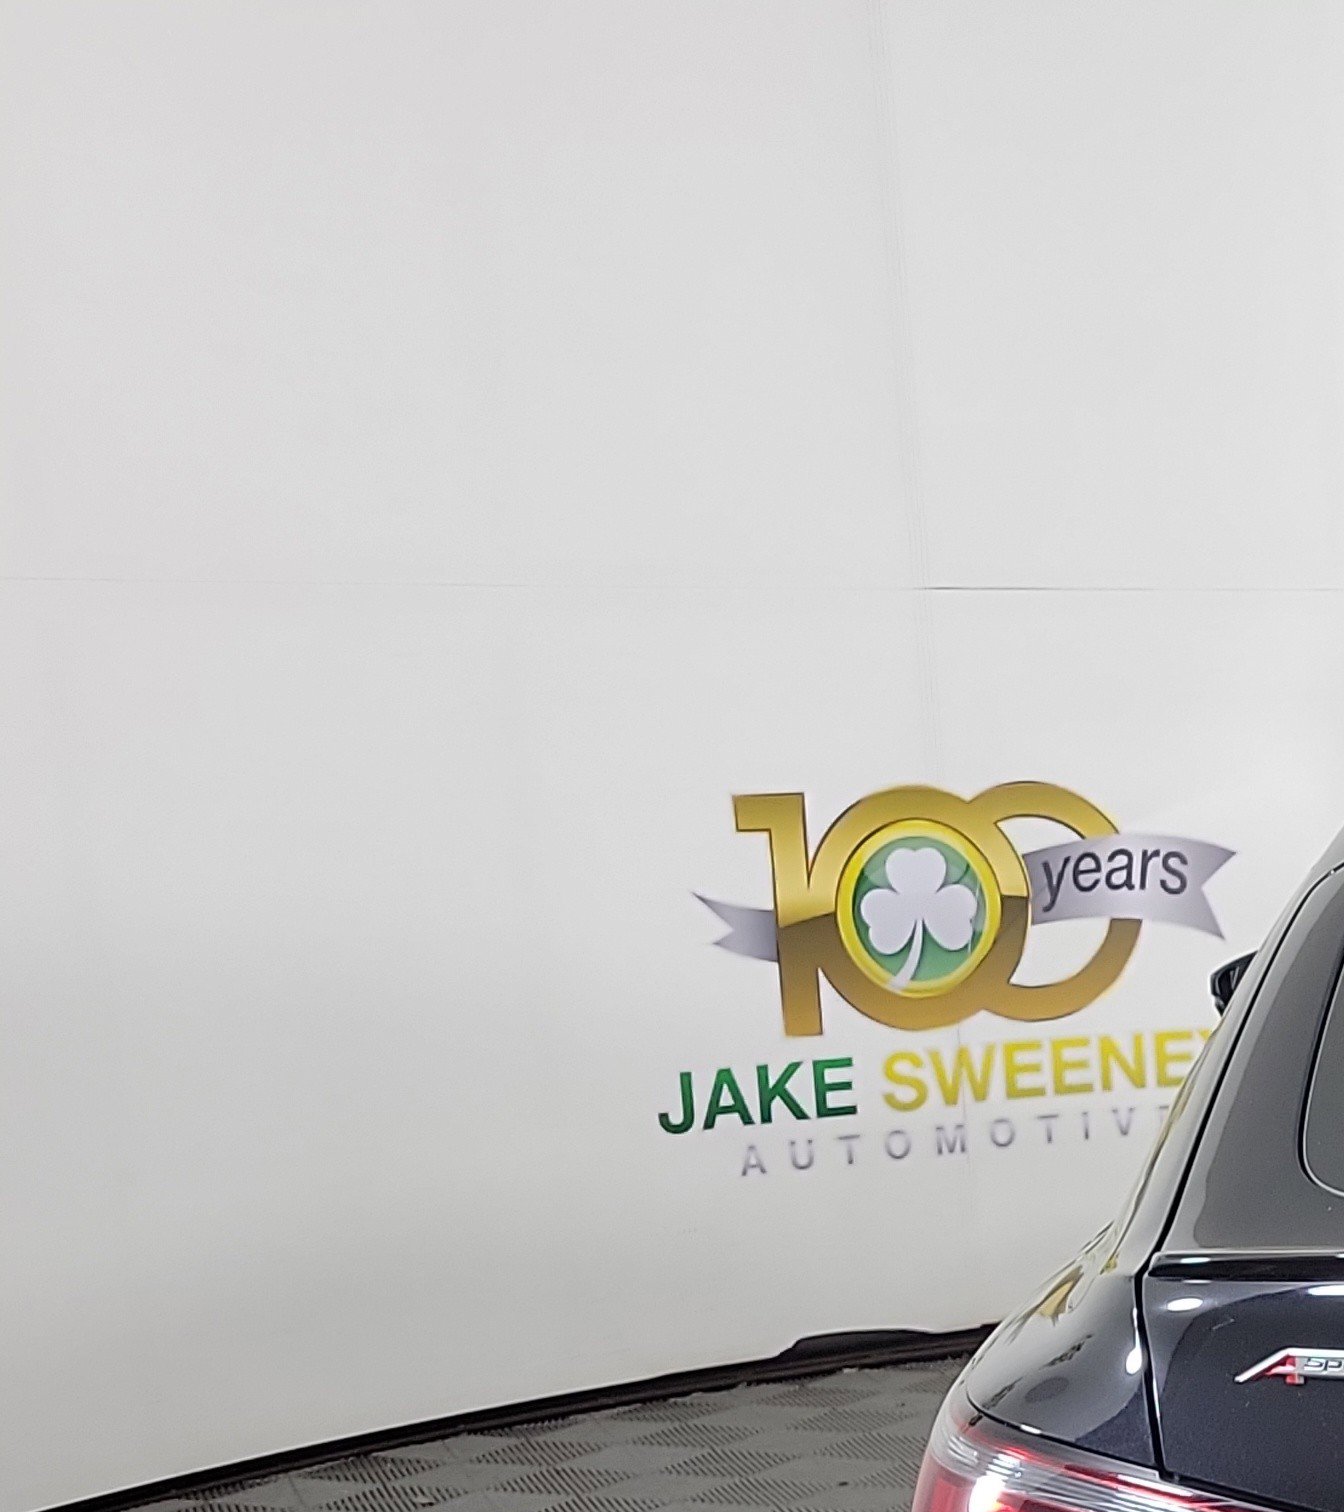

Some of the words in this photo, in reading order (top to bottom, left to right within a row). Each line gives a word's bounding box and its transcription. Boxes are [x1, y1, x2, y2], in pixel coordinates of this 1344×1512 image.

[1041, 846, 1189, 911] years
[658, 1056, 858, 1135] JAKE
[882, 1028, 1212, 1112] SWEENE
[740, 1104, 1170, 1177] AUTOMOTIV
